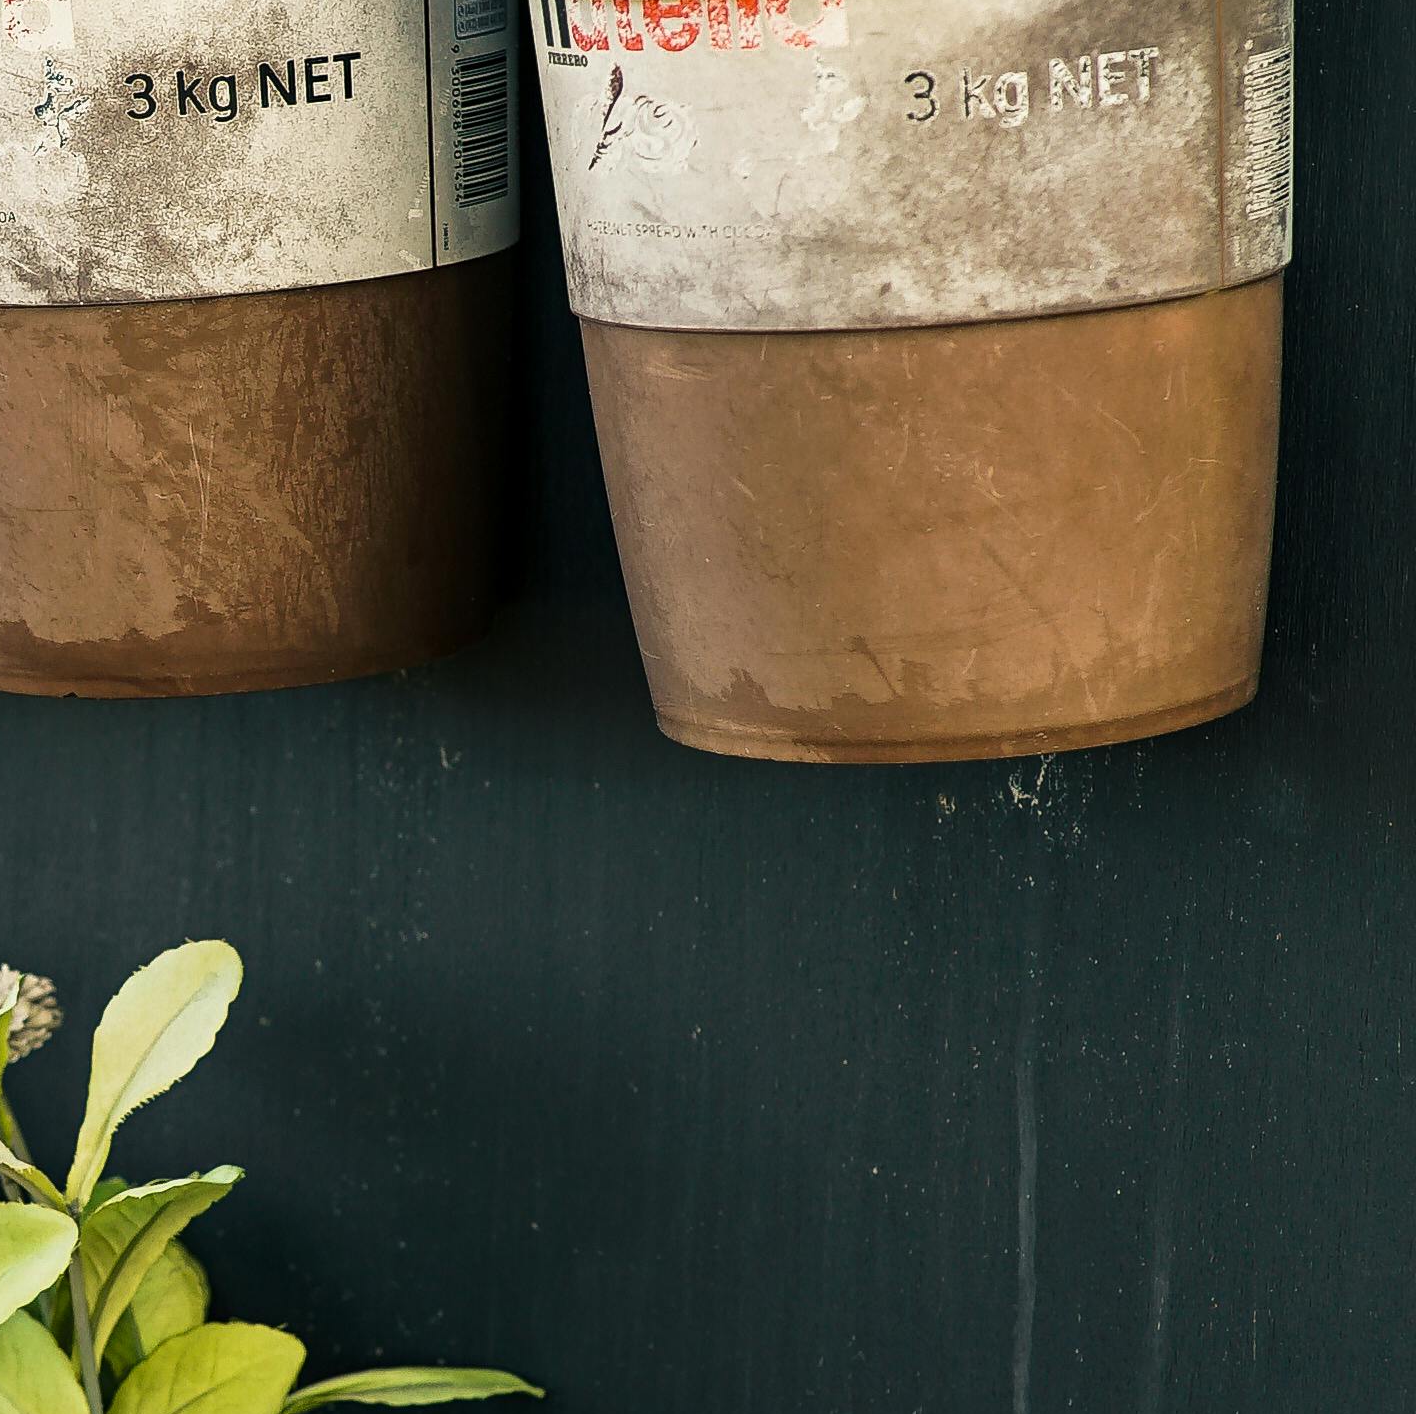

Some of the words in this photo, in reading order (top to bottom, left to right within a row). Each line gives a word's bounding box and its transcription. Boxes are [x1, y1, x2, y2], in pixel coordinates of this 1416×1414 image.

[124, 73, 157, 120] 3
[176, 71, 237, 122] kg
[259, 51, 361, 108] NET
[904, 70, 937, 121] 3
[959, 68, 1028, 128] kg
[1048, 47, 1159, 111] NET
